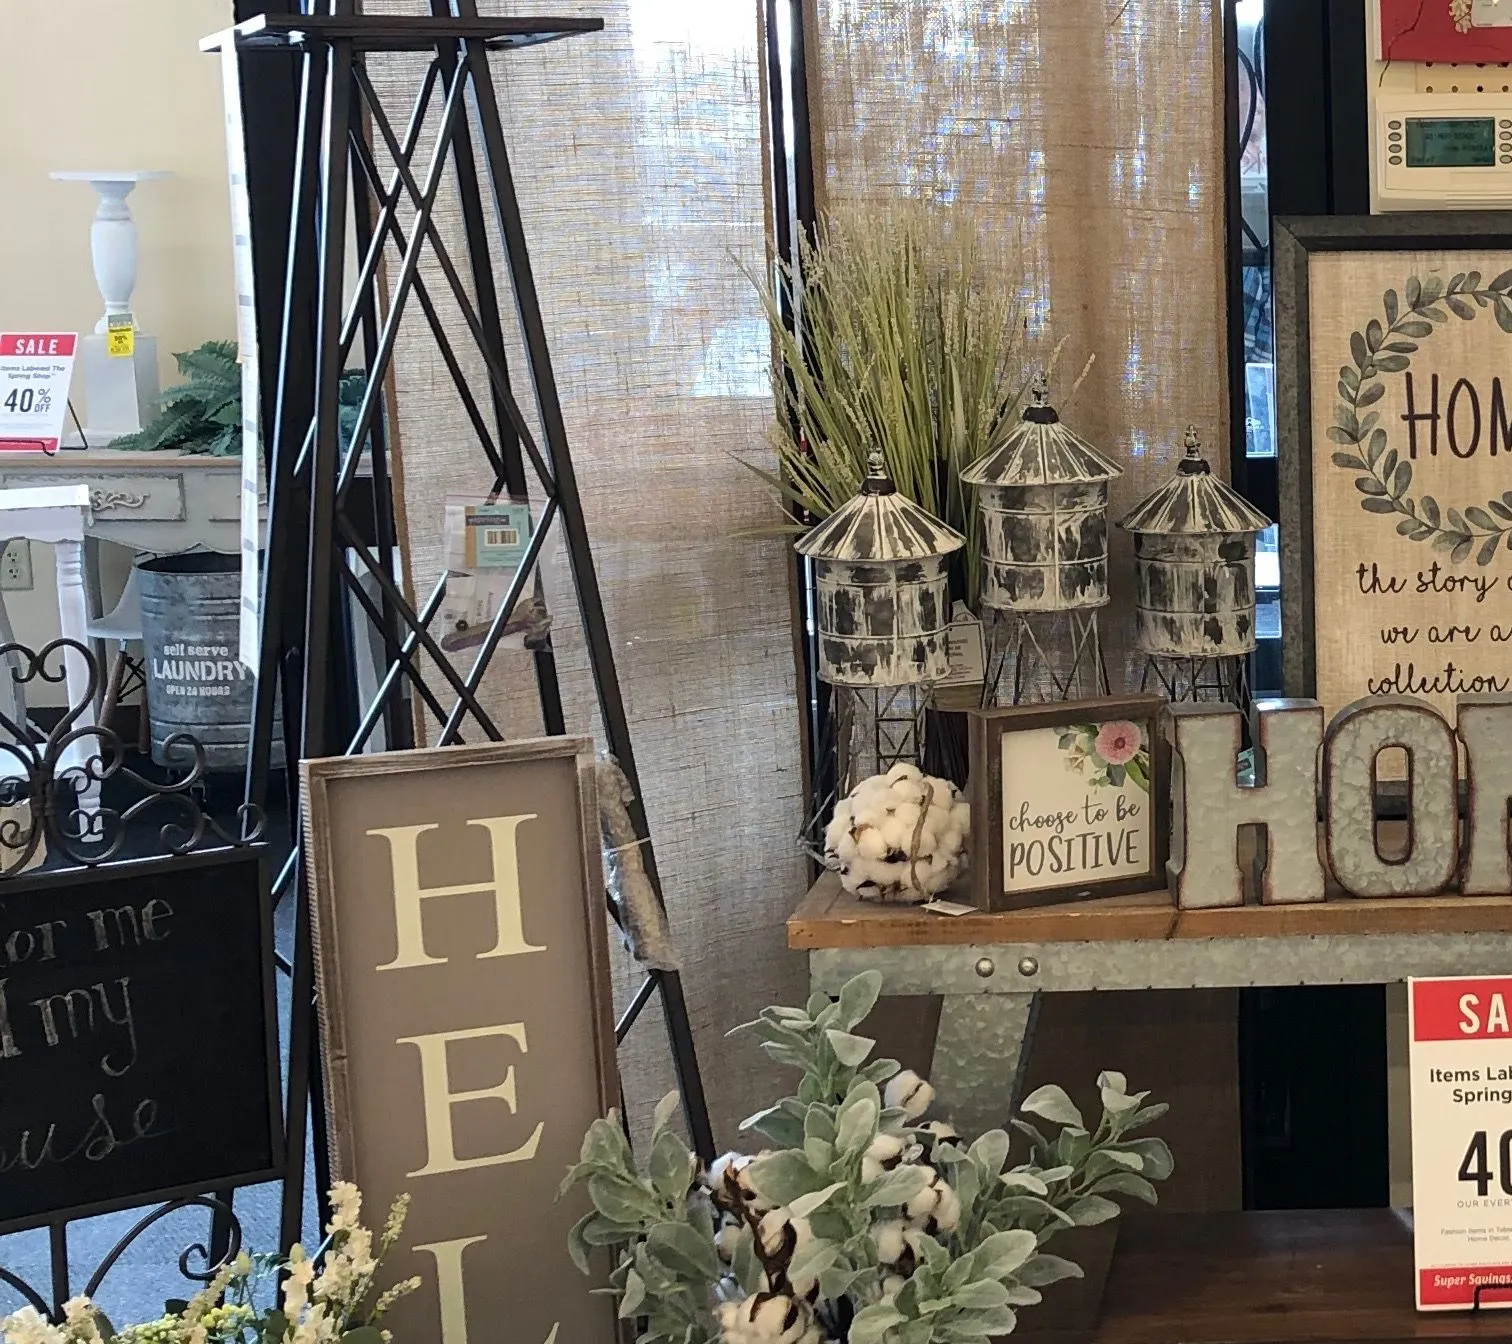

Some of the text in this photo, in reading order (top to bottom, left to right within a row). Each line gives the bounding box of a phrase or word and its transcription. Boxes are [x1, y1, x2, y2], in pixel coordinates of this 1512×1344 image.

[15, 338, 60, 354] SALE
[34, 403, 52, 413] OFF
[1356, 562, 1408, 594] the
[1415, 561, 1499, 603] story
[1380, 628, 1420, 644] we
[1427, 625, 1481, 642] are
[187, 645, 229, 657] serve
[153, 658, 247, 681] LAUNDRY
[1367, 662, 1510, 695] collection
[1009, 794, 1141, 834] choose to be
[1009, 827, 1140, 879] POSITIVE
[86, 899, 174, 952] me
[28, 976, 139, 1078] my
[1430, 1068, 1480, 1083] Items
[1452, 1086, 1512, 1104] Spring
[1456, 1199, 1479, 1208] OUR
[1434, 1274, 1466, 1288] Super
